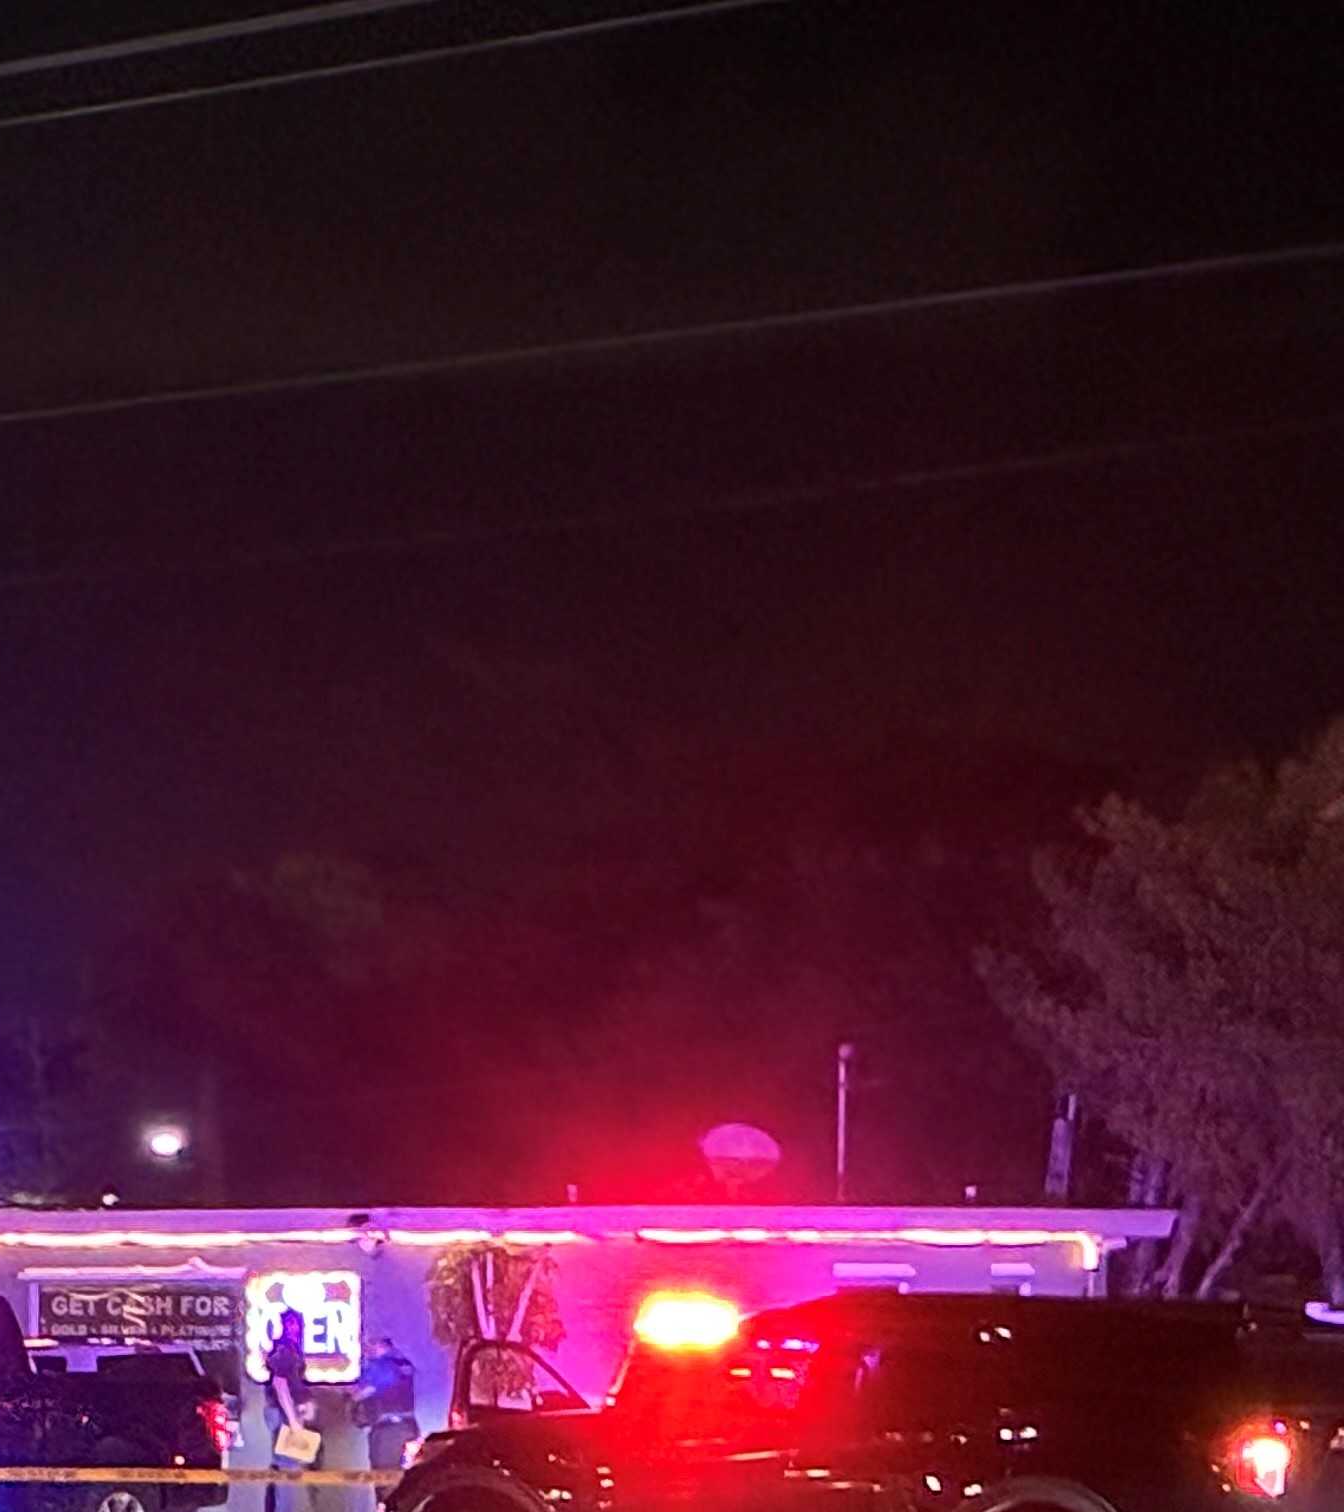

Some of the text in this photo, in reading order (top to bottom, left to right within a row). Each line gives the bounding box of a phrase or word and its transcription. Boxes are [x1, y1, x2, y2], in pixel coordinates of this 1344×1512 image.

[50, 1295, 97, 1316] GET
[180, 1294, 230, 1316] FOR
[256, 1308, 355, 1354] OEN
